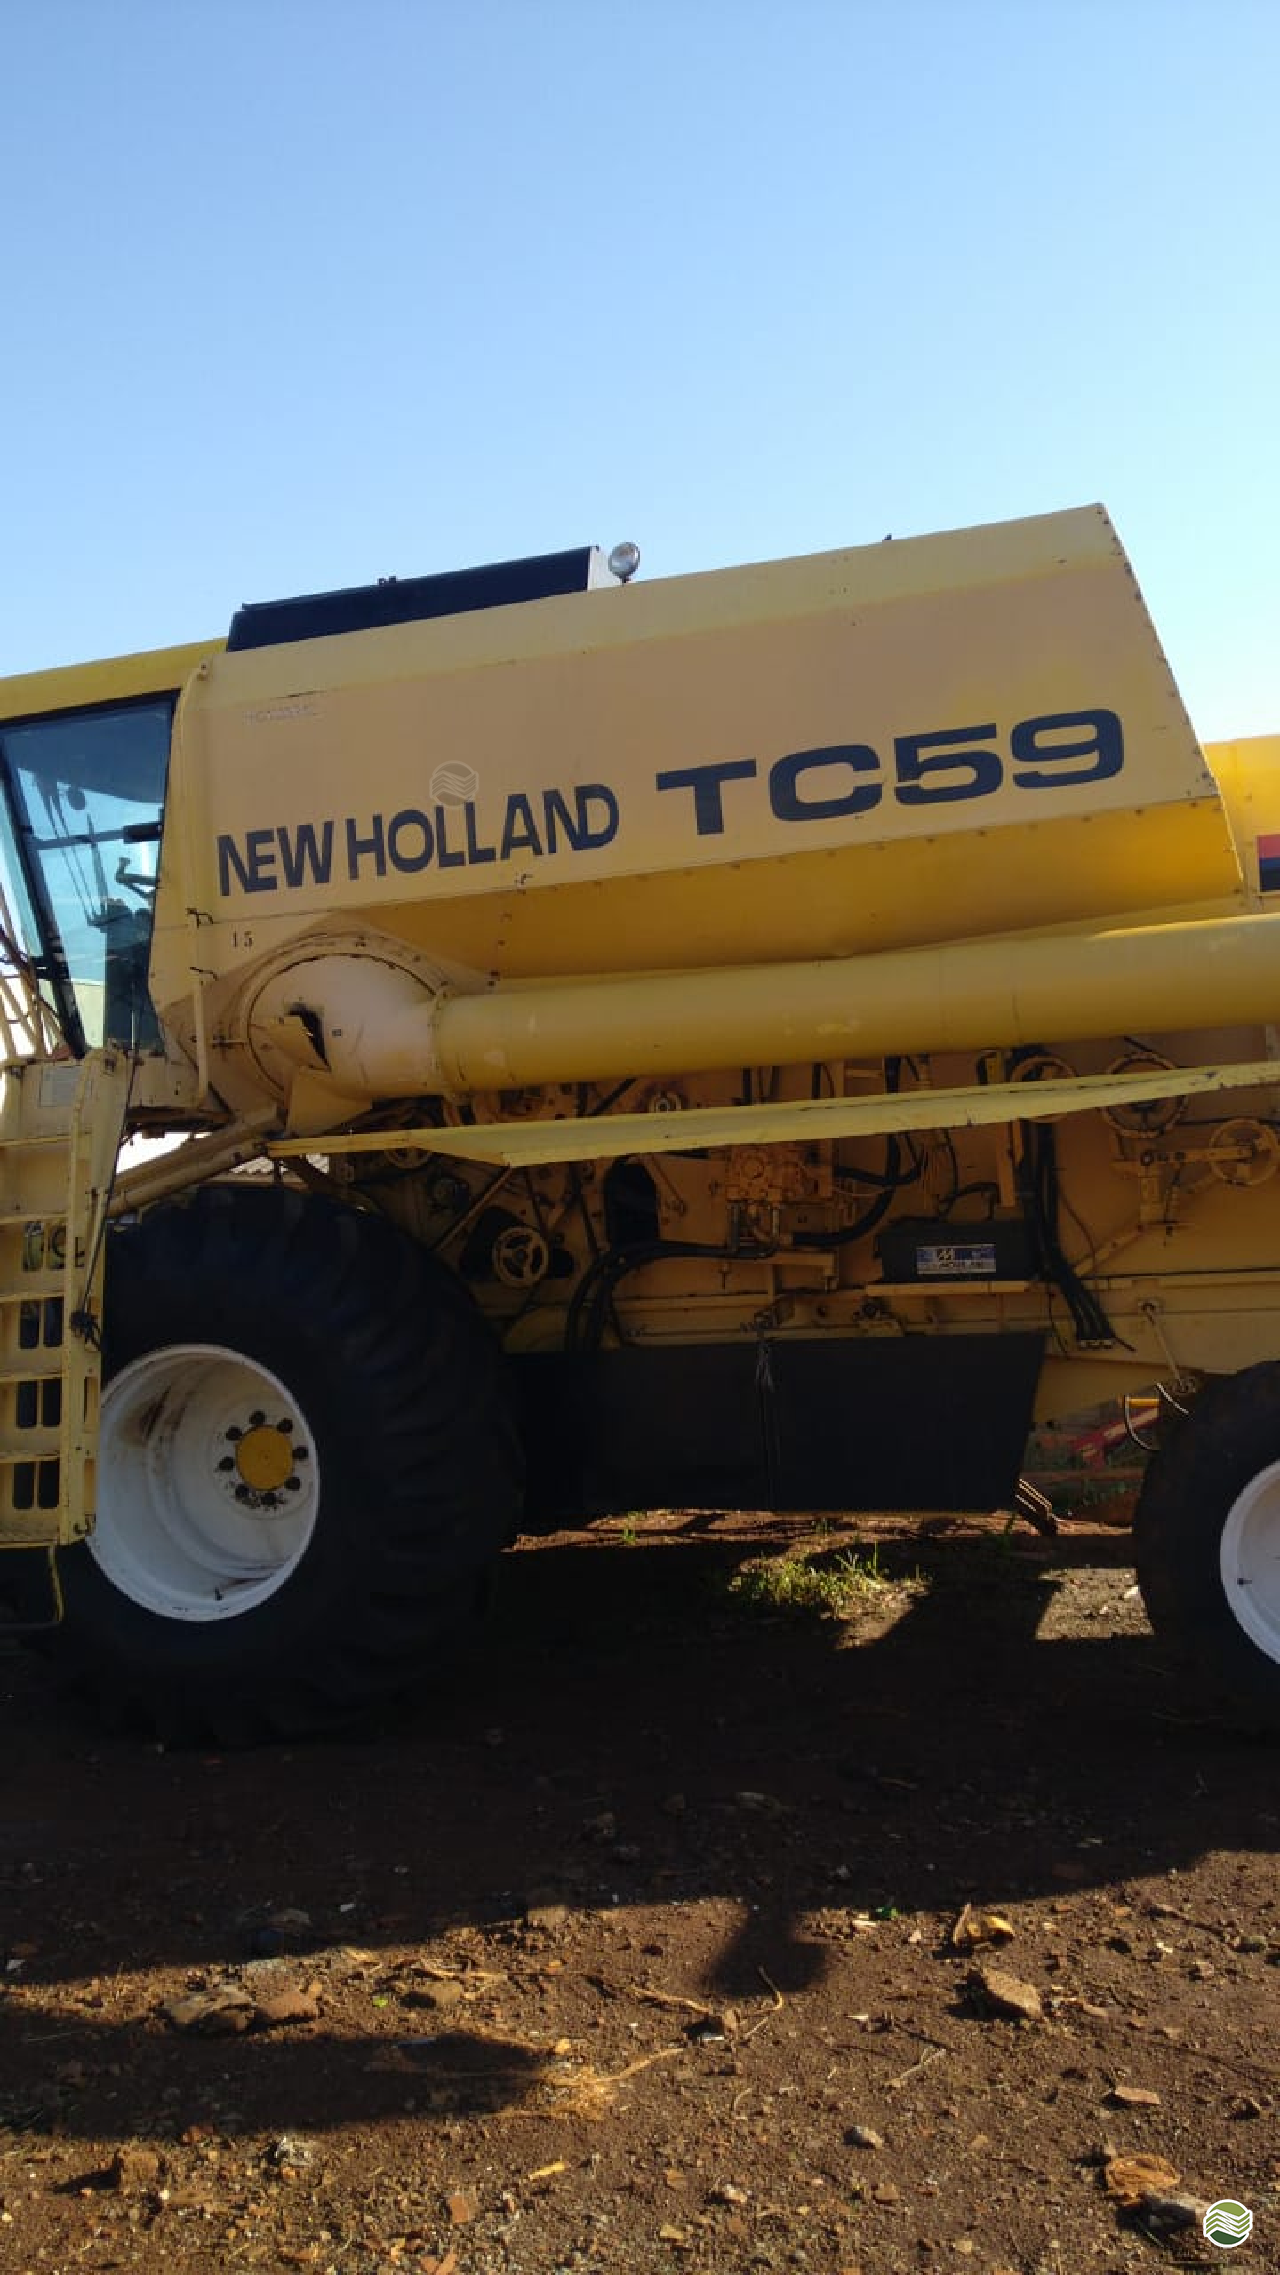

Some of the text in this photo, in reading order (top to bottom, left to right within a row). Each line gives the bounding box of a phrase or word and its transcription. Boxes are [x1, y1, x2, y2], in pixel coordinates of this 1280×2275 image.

[655, 708, 1125, 836] TC59
[216, 783, 620, 897] NEW HOLLAND
